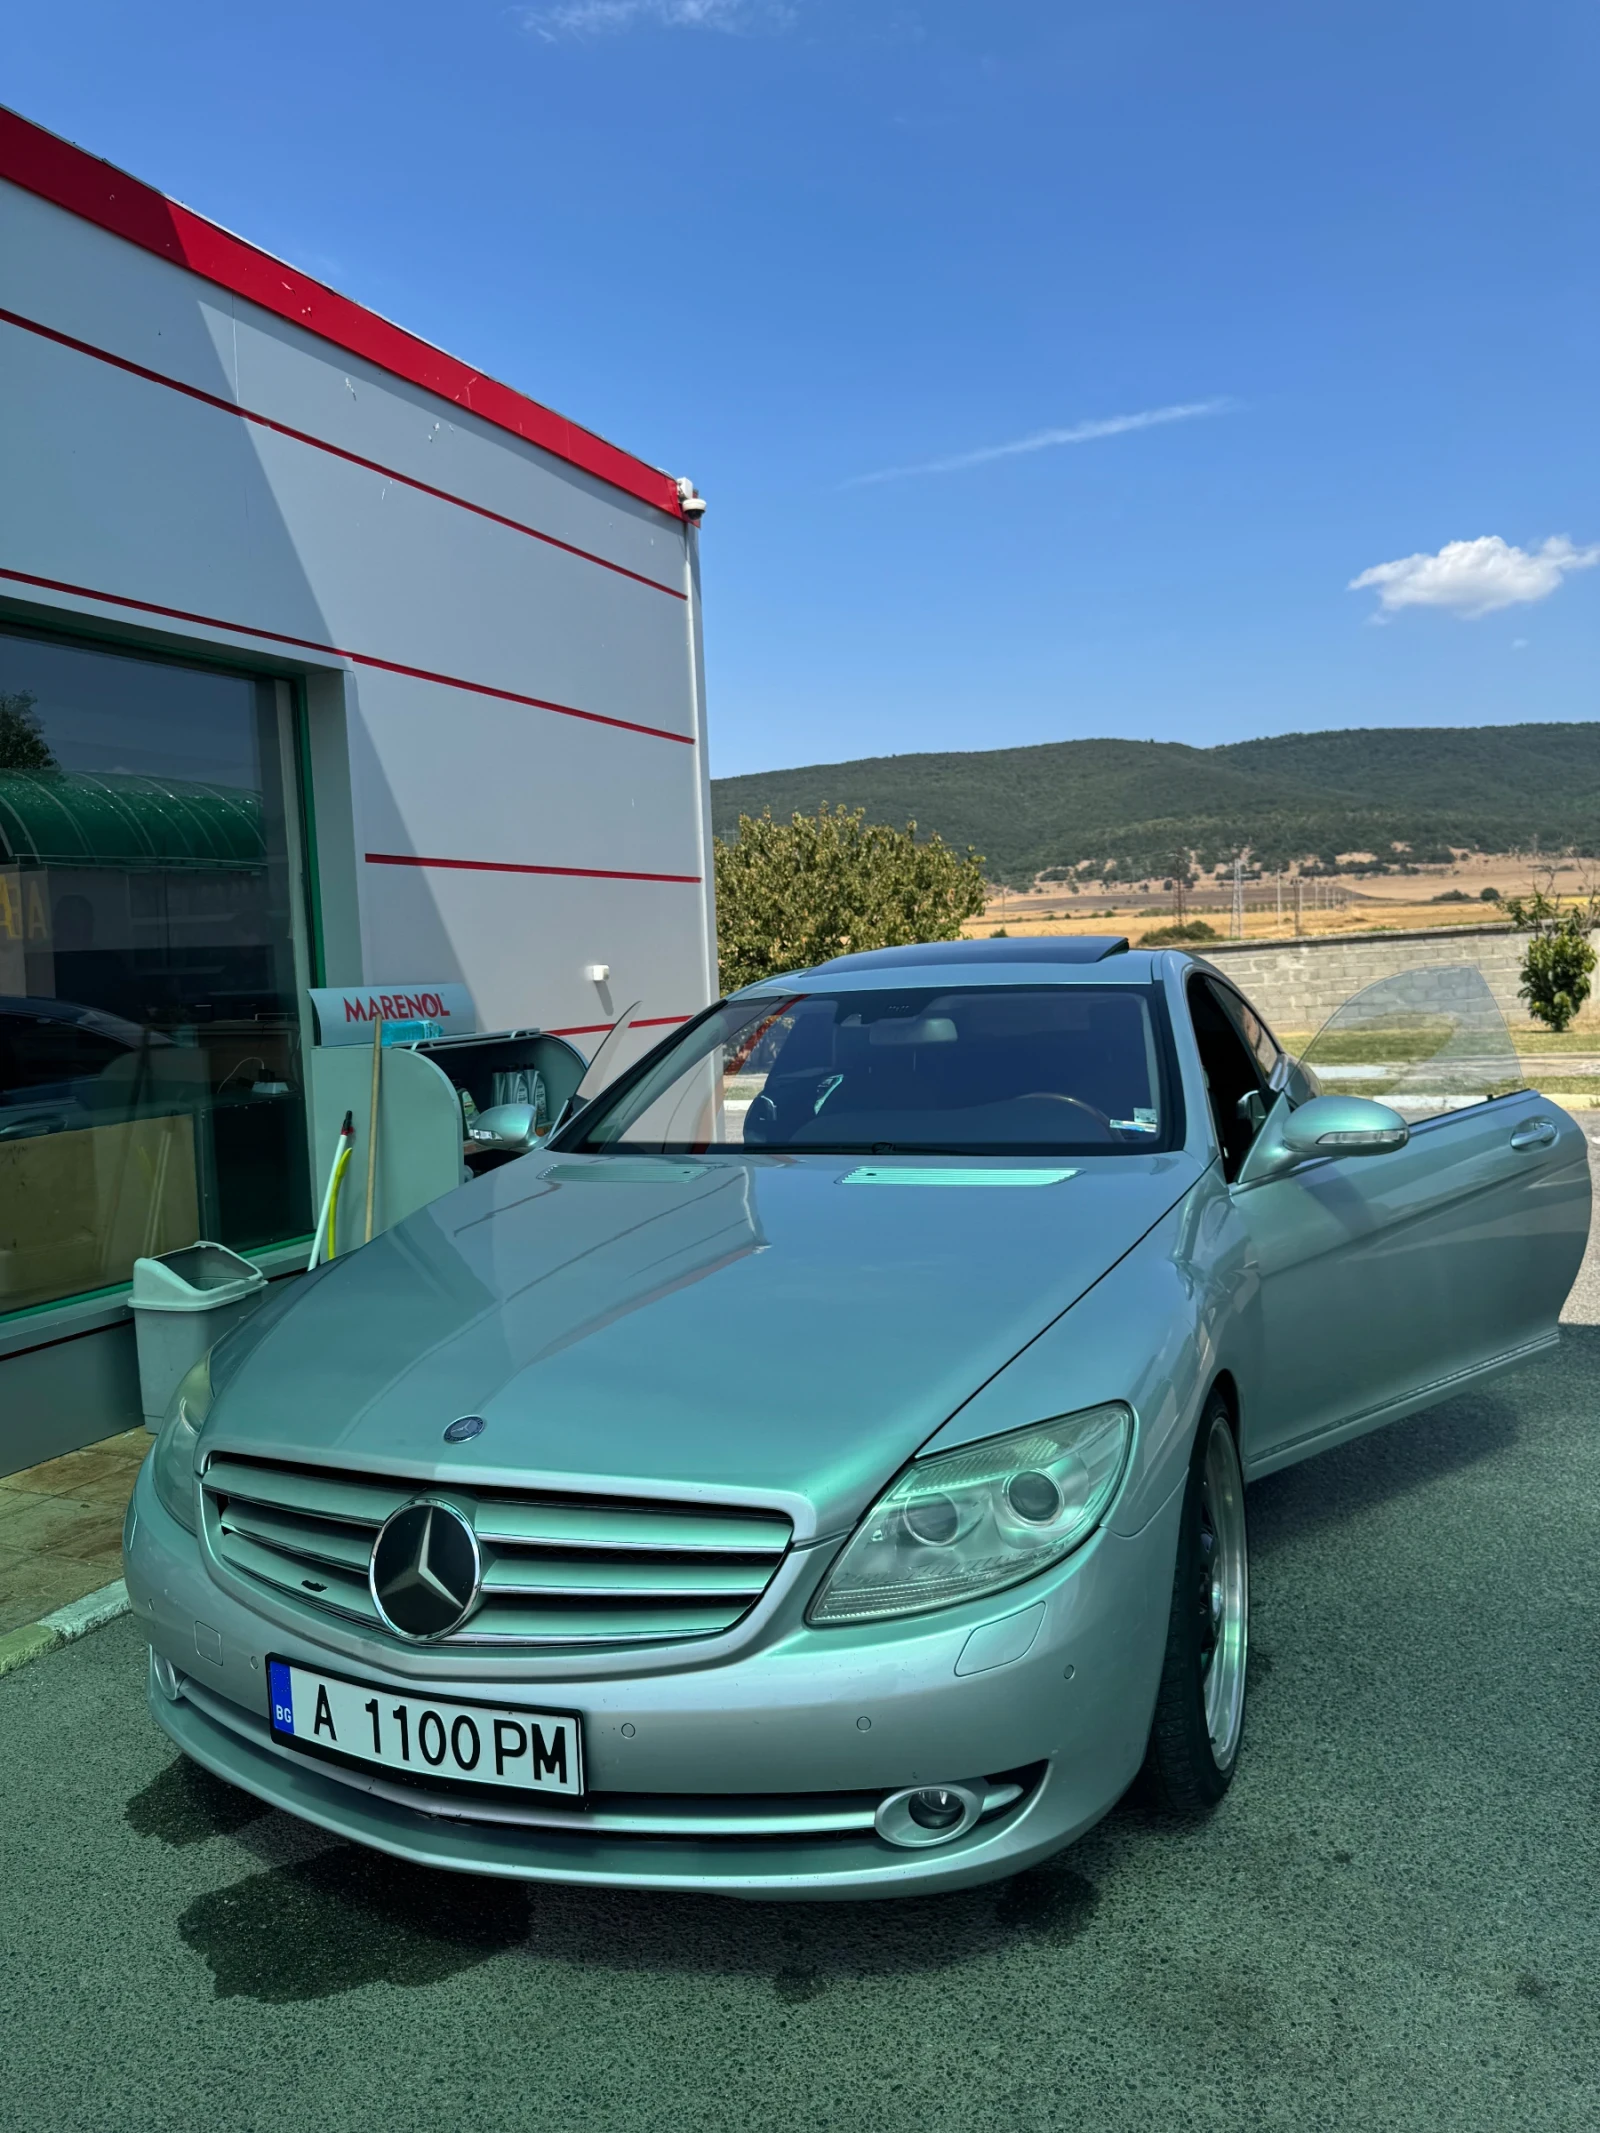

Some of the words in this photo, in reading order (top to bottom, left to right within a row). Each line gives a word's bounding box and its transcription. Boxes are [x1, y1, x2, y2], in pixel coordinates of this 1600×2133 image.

[343, 993, 450, 1022] MARENOL
[275, 1704, 293, 1724] BG
[313, 1683, 338, 1741] A
[365, 1698, 481, 1771] 1100
[493, 1718, 569, 1784] PM
